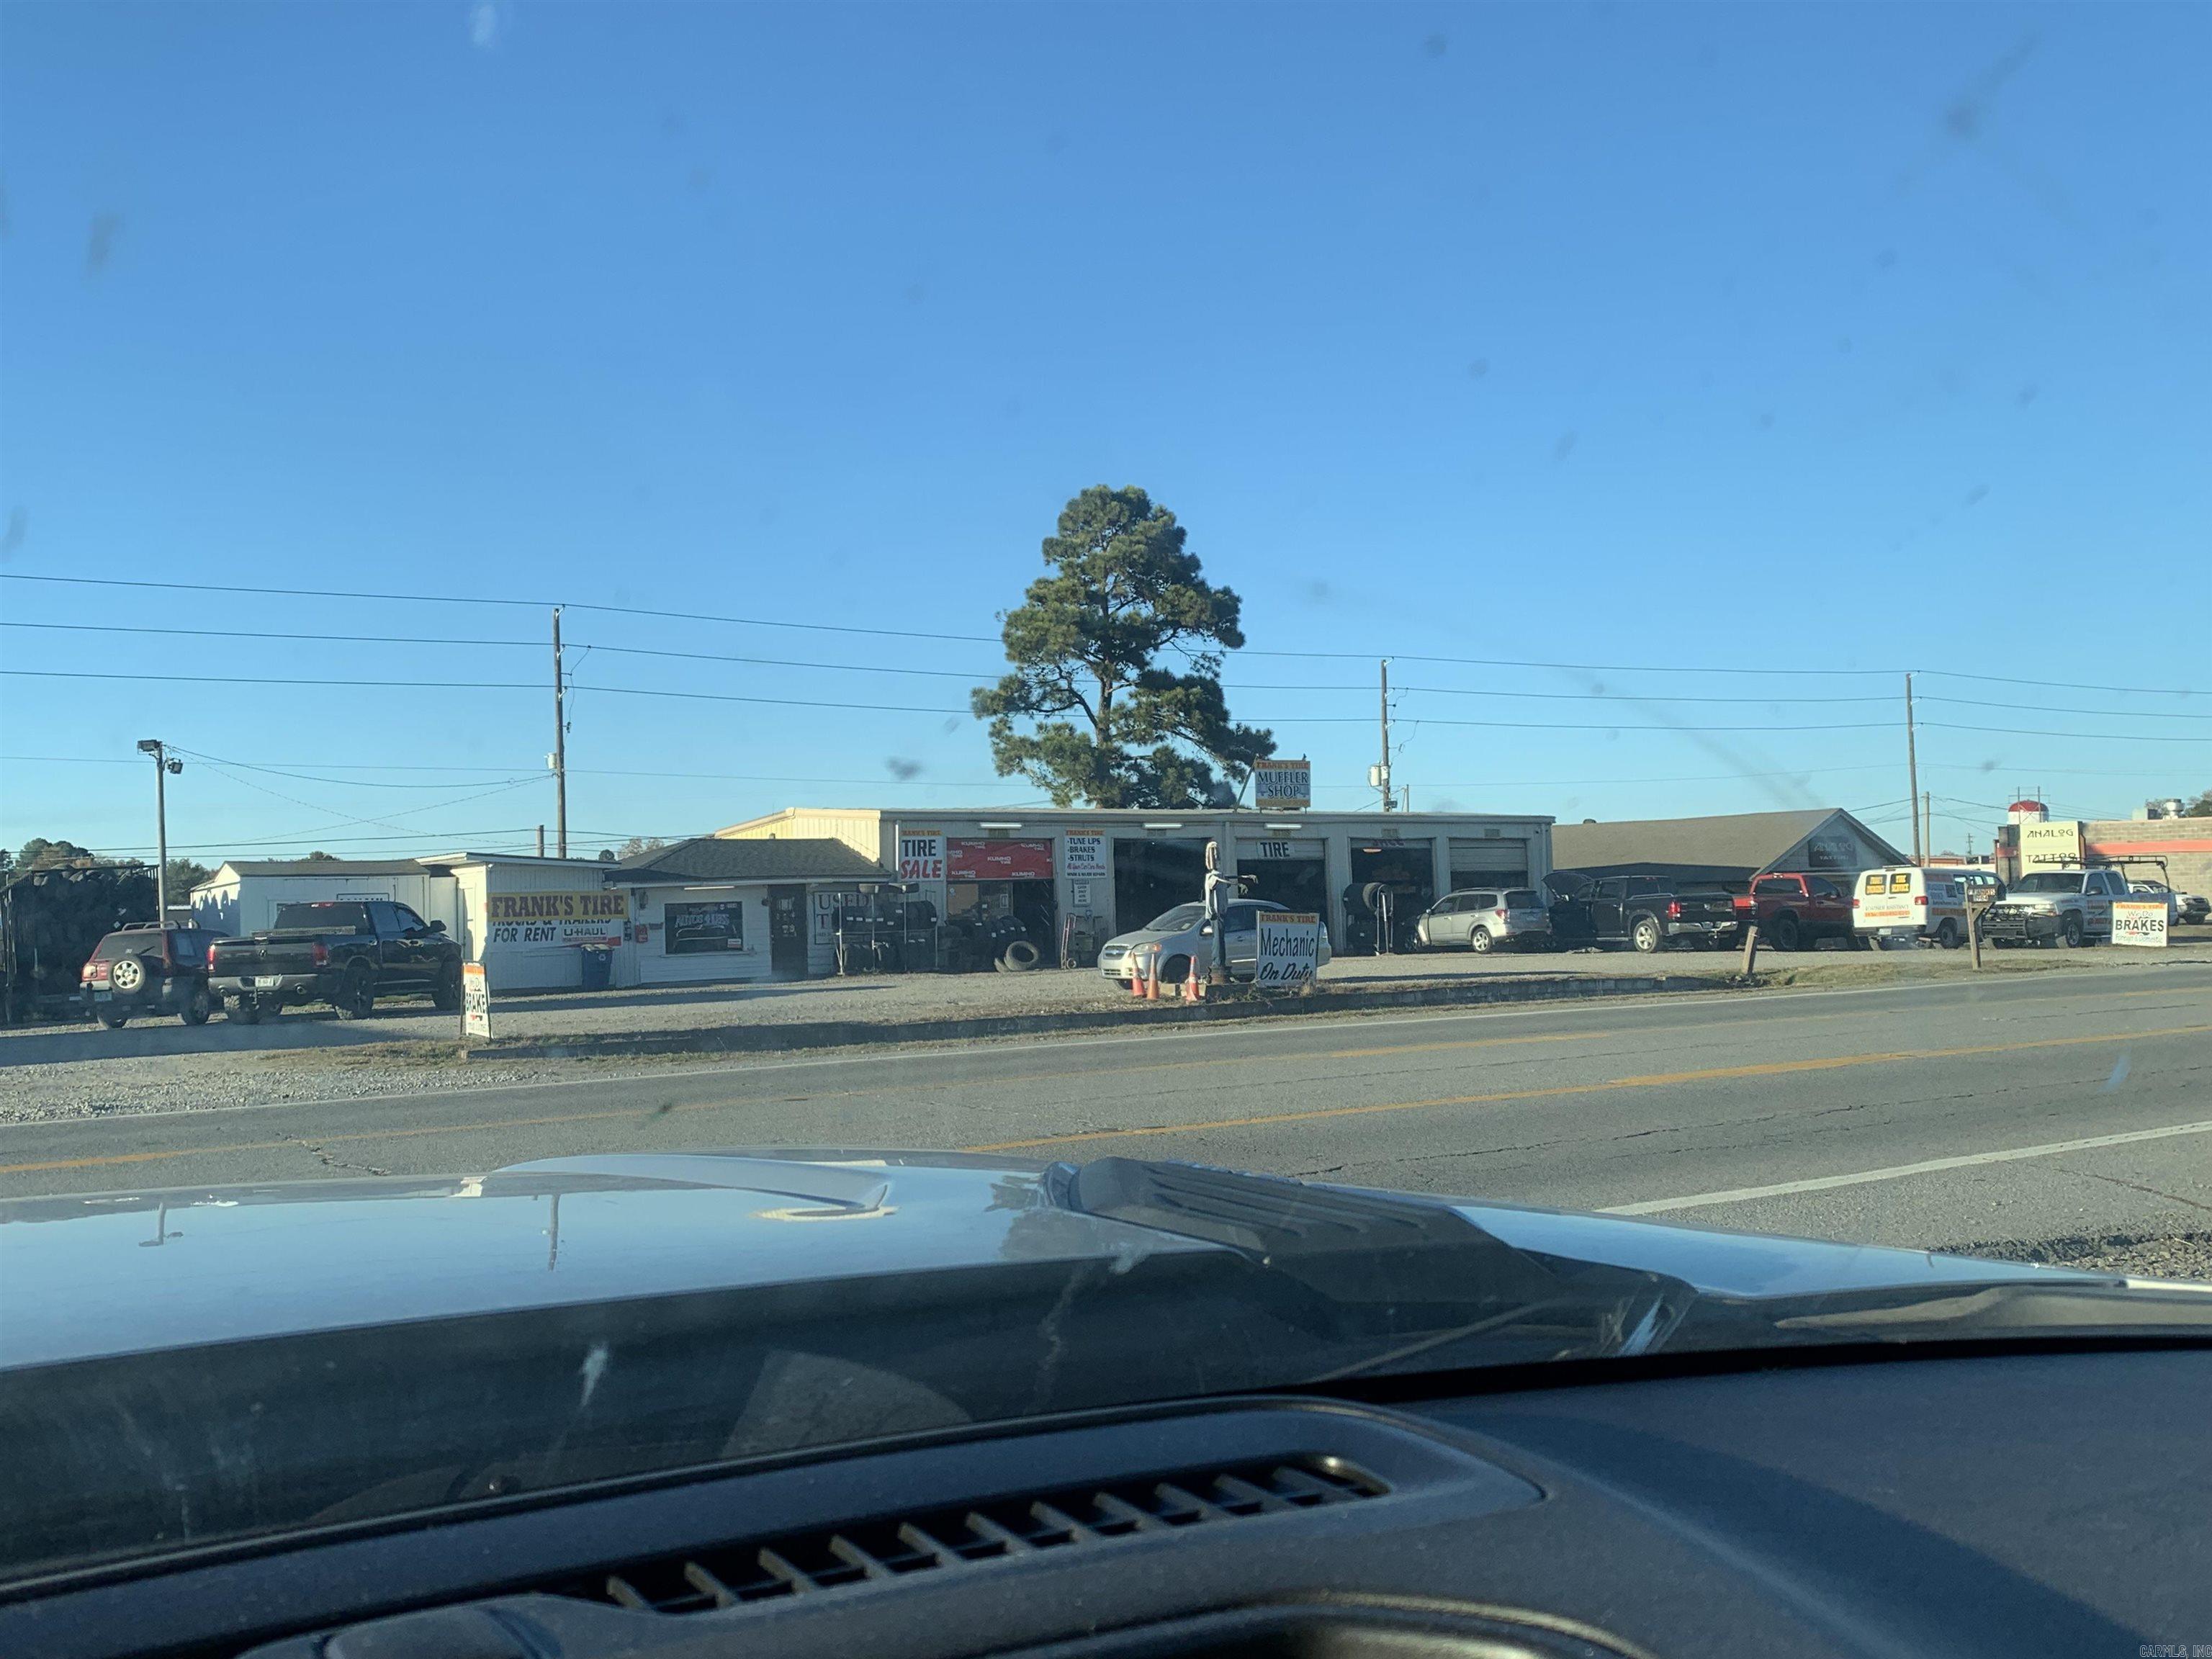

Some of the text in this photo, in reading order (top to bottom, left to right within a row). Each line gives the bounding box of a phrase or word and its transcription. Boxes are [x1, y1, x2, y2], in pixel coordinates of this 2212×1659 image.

[1258, 771, 1309, 784] MUFFLER
[1267, 785, 1300, 798] SHOP
[2027, 829, 2074, 838] ANALOG
[902, 840, 937, 857] TIRE
[1260, 842, 1290, 858] TIRE
[2026, 853, 2077, 863] TATTOO
[901, 860, 943, 879] SALE
[490, 894, 624, 918] FRANK'S TIRE
[564, 927, 606, 936] U-HAUL
[2116, 920, 2164, 932] BRAKES
[493, 927, 557, 943] FOR RENT
[1261, 927, 1315, 957] Mechanic
[1260, 962, 1313, 982] On Duty
